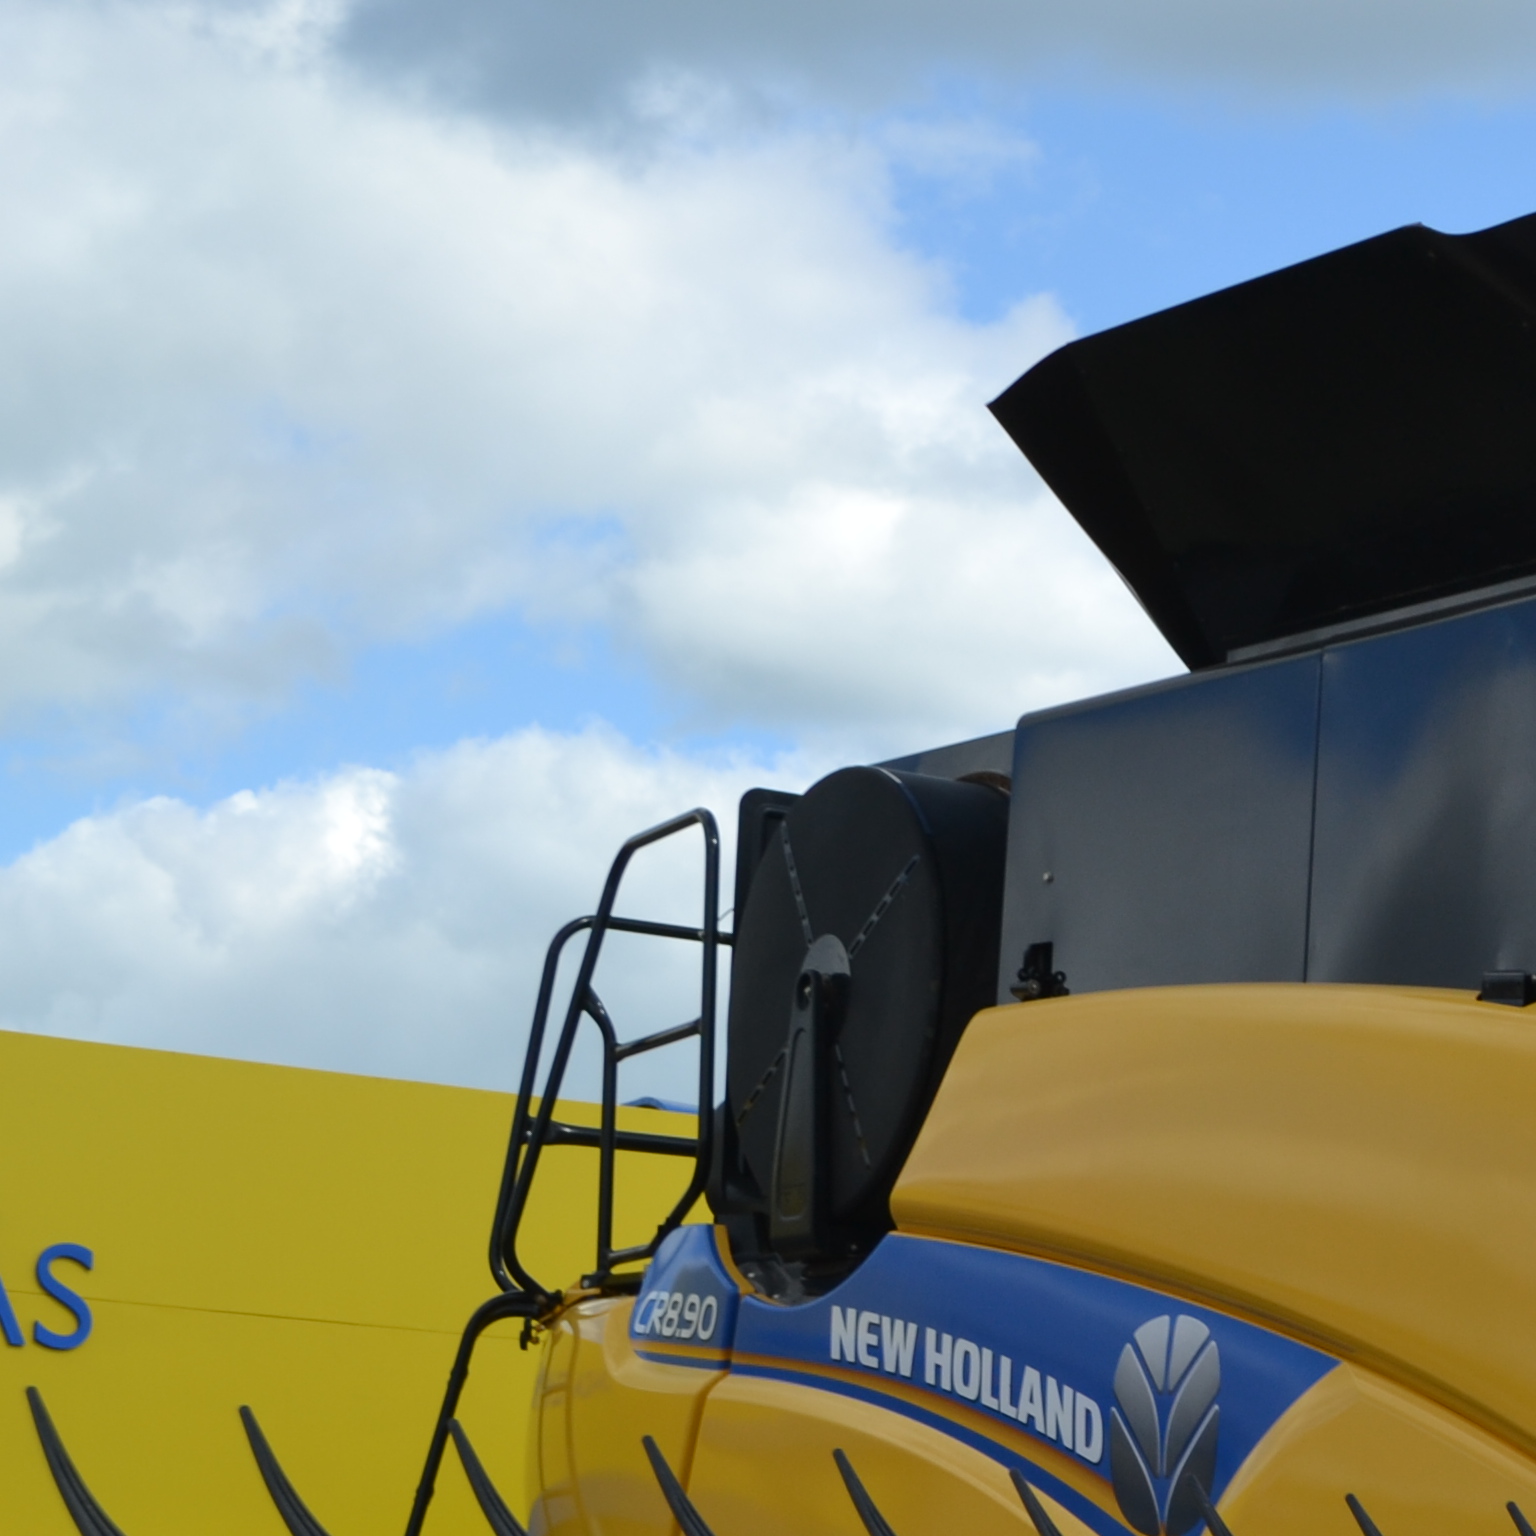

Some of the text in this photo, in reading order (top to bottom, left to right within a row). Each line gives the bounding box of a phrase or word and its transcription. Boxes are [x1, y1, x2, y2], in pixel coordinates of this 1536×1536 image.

[633, 1290, 718, 1341] CR8.90
[830, 1305, 1104, 1464] NEW HOLLAND
